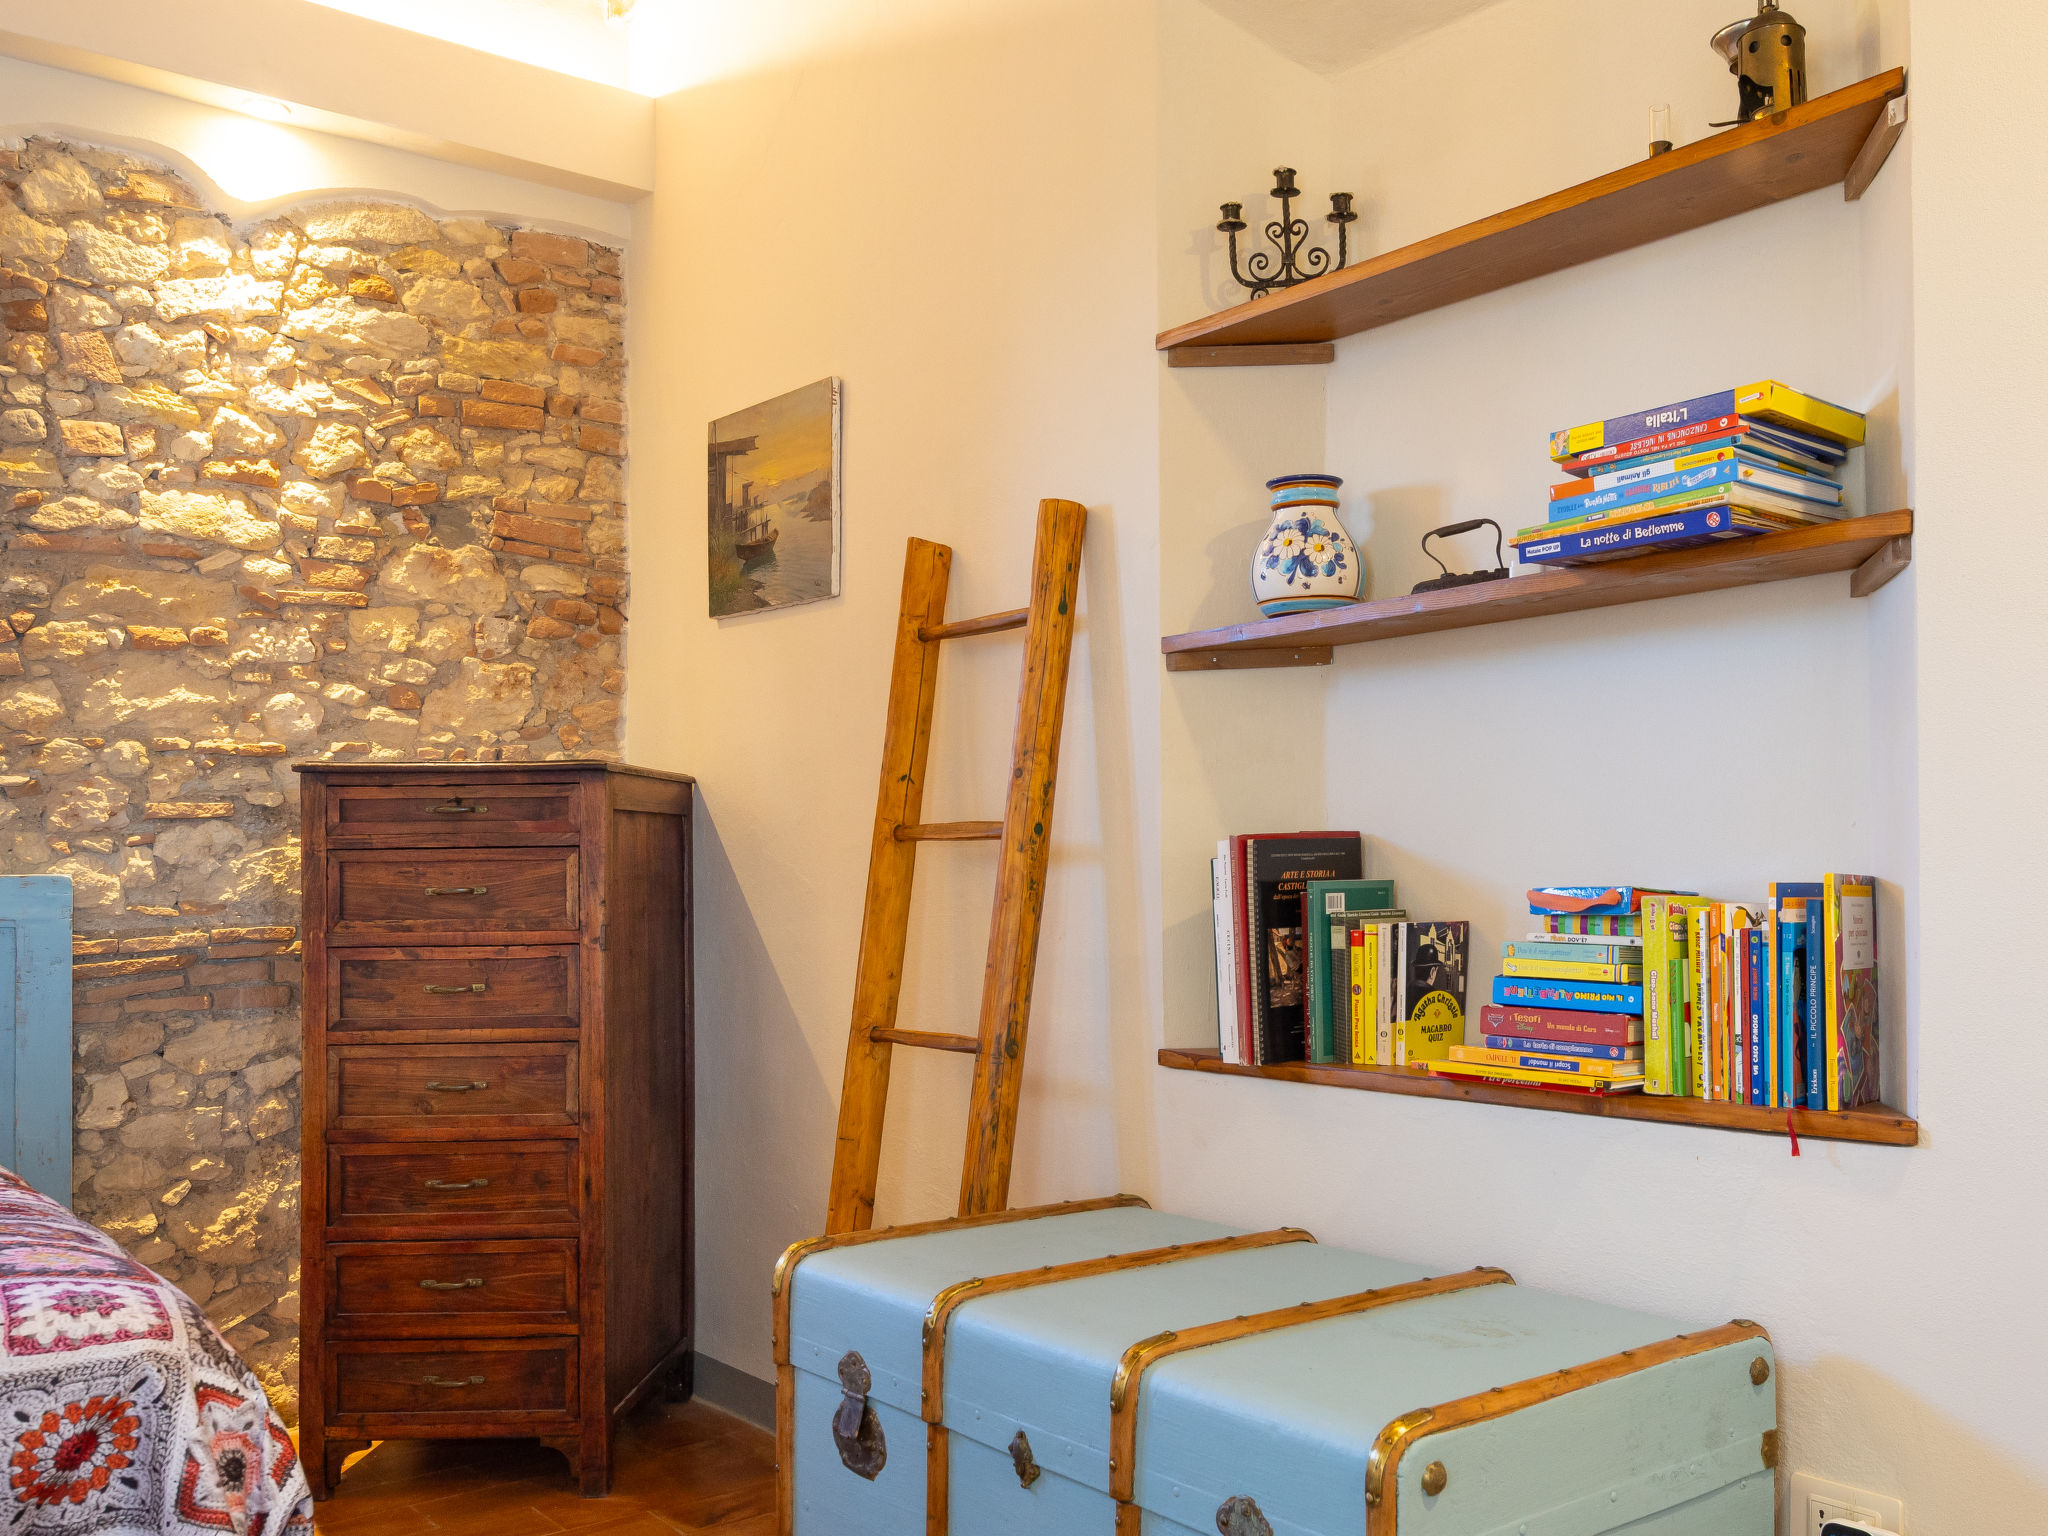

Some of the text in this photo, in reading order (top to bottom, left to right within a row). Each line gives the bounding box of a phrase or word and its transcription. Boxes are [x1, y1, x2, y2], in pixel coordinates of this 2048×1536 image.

[1645, 407, 1688, 428] L'Italia
[1630, 437, 1655, 451] INGLESE
[1616, 468, 1651, 484] gli Animali
[1580, 521, 1684, 548] La notte di Betlemme
[1281, 870, 1299, 879] ARTE
[1306, 870, 1330, 879] STORIA
[1278, 882, 1308, 891] CASTIGL
[1650, 970, 1658, 990] Ciao,
[1574, 991, 1601, 1002] PRIMO
[1414, 996, 1436, 1022] Agatha
[1437, 993, 1459, 1019] Christie
[1513, 1012, 1541, 1024] Tesori
[1421, 1024, 1452, 1034] MACABRO
[1651, 1011, 1659, 1039] Masha!
[1428, 1033, 1444, 1043] QUIZ
[1486, 1053, 1509, 1063] TEMPO
[1554, 1062, 1571, 1070] Scopri
